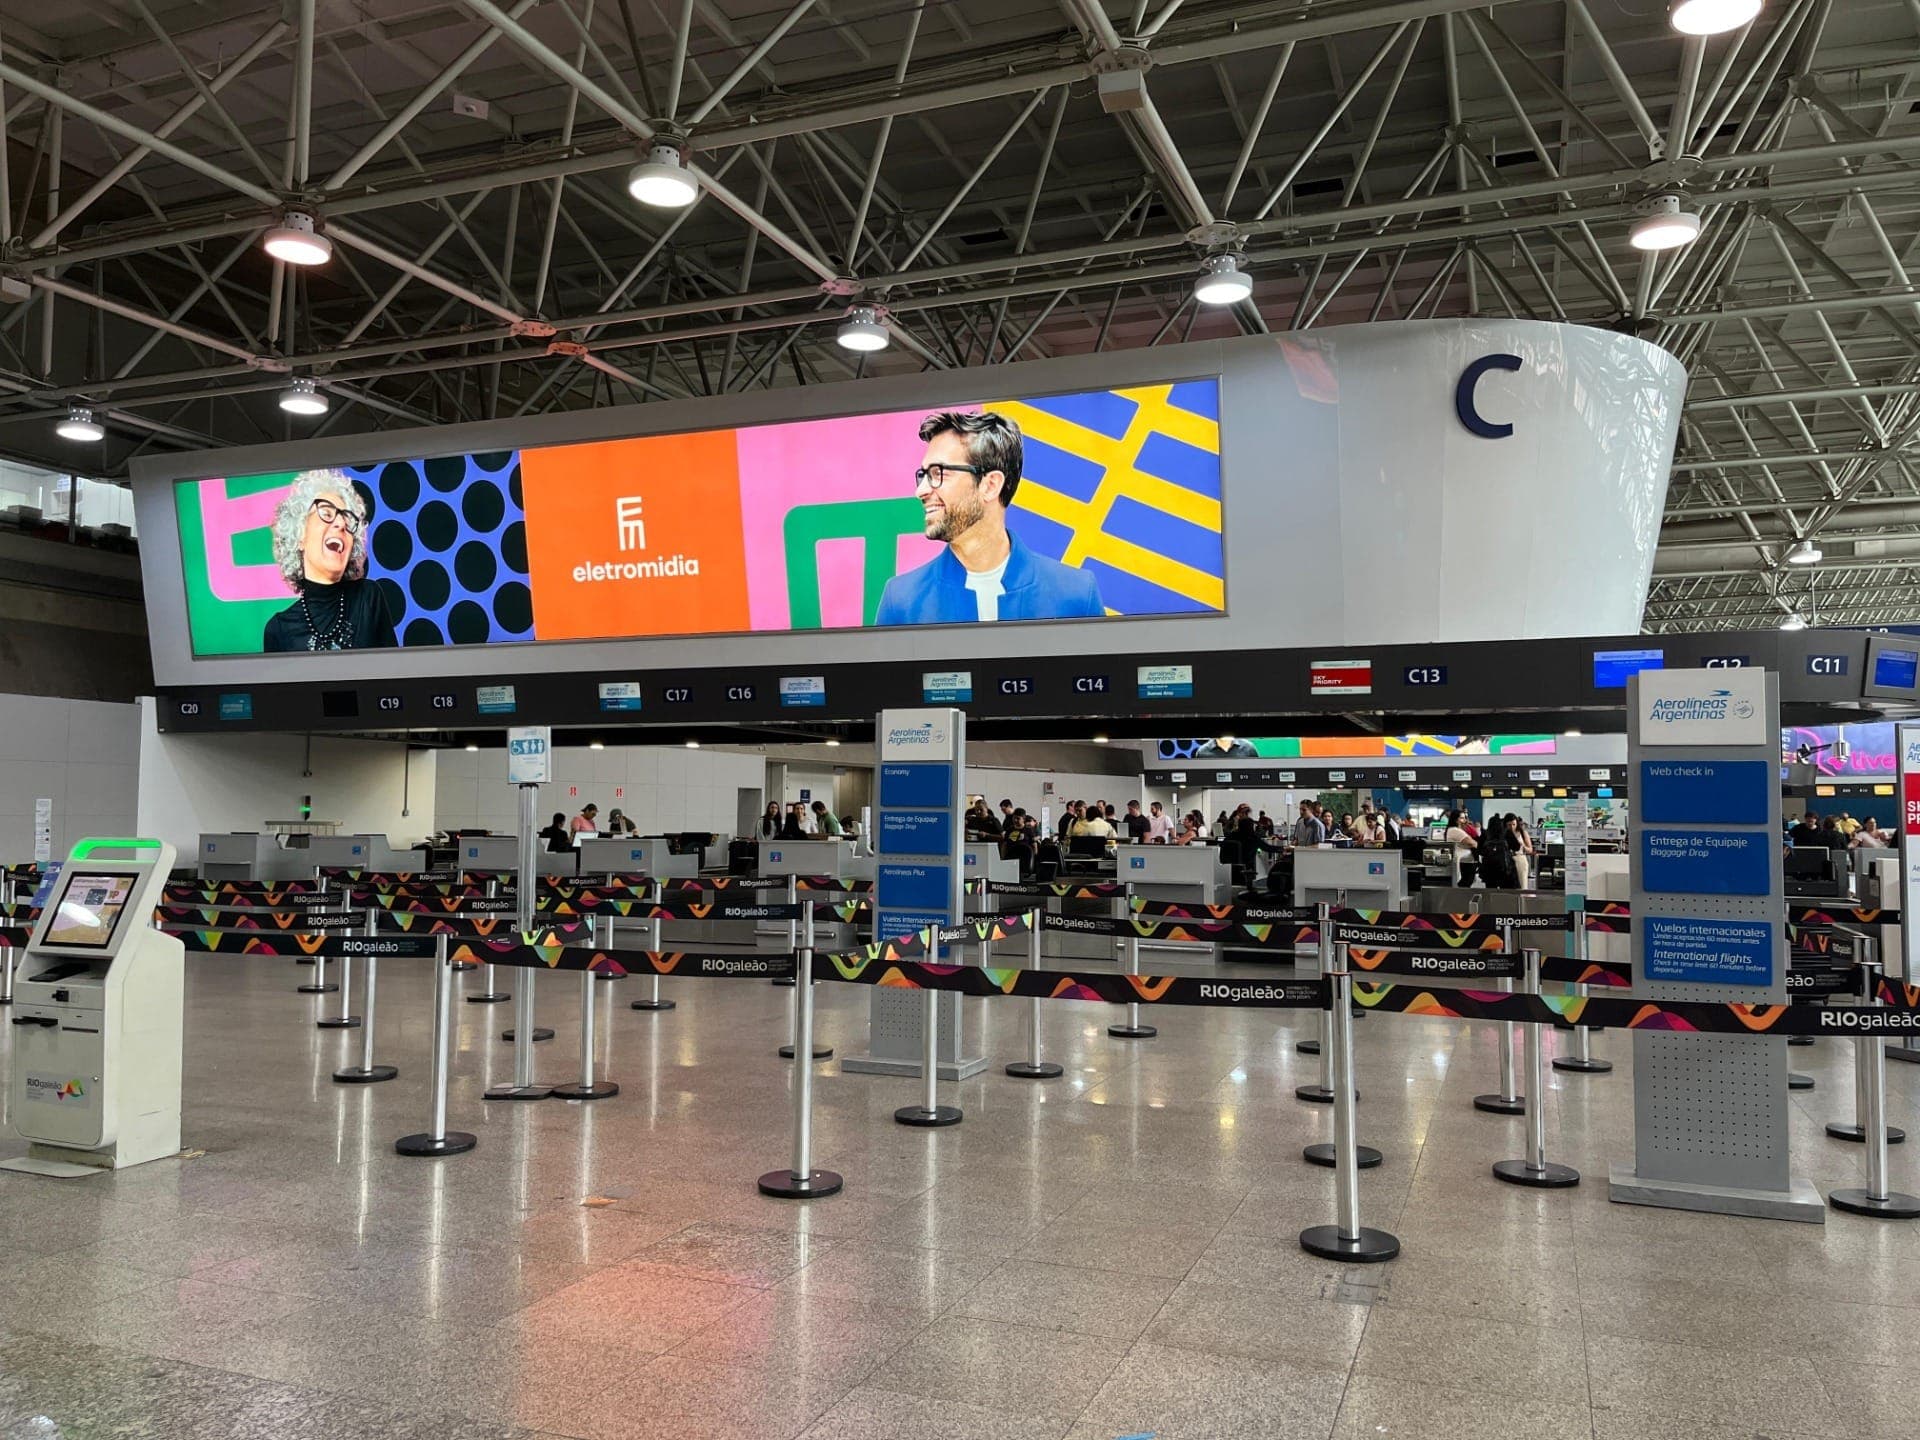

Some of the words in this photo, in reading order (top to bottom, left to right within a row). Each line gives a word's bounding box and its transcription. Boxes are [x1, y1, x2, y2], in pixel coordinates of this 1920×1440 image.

[1456, 353, 1523, 439] C
[572, 554, 699, 582] eletromidia
[1811, 657, 1840, 673] C11
[1408, 669, 1440, 683] C13
[1002, 680, 1028, 694] C15
[1076, 678, 1104, 692] C14
[666, 689, 688, 701] C17
[728, 688, 752, 700] C16
[380, 698, 399, 709] C19
[433, 696, 454, 708] C18
[181, 703, 198, 714] C20
[1650, 709, 1725, 722] Argentinas
[888, 736, 930, 746] Argentinas
[884, 768, 910, 777] Economy
[1650, 767, 1672, 776] Web
[1674, 767, 1702, 776] check
[1704, 767, 1714, 776] in
[884, 816, 906, 824] Entrega
[1650, 836, 1688, 848] Entrega
[1690, 836, 1703, 846] de
[1706, 837, 1748, 848] Equipaje
[1651, 848, 1687, 858] Baggage
[1688, 849, 1710, 858] Drop
[725, 907, 769, 918] RIOgaleão
[1246, 909, 1294, 919] RIOgaleão
[308, 916, 350, 928] RIOgaleão
[1046, 917, 1096, 930] RIOgaleão
[1496, 917, 1550, 928] RIOgaleão
[1339, 928, 1398, 942] RIOgaleão
[1652, 922, 1688, 934] Vuelos
[1689, 924, 1767, 938] internacionales
[343, 941, 398, 954] RIOgaleão
[1654, 948, 1718, 962] International
[1719, 952, 1752, 966] flights
[702, 959, 768, 974] RIOgaleão
[1412, 956, 1486, 972] RIOgaleão
[1200, 984, 1284, 1001] RIOgaleão
